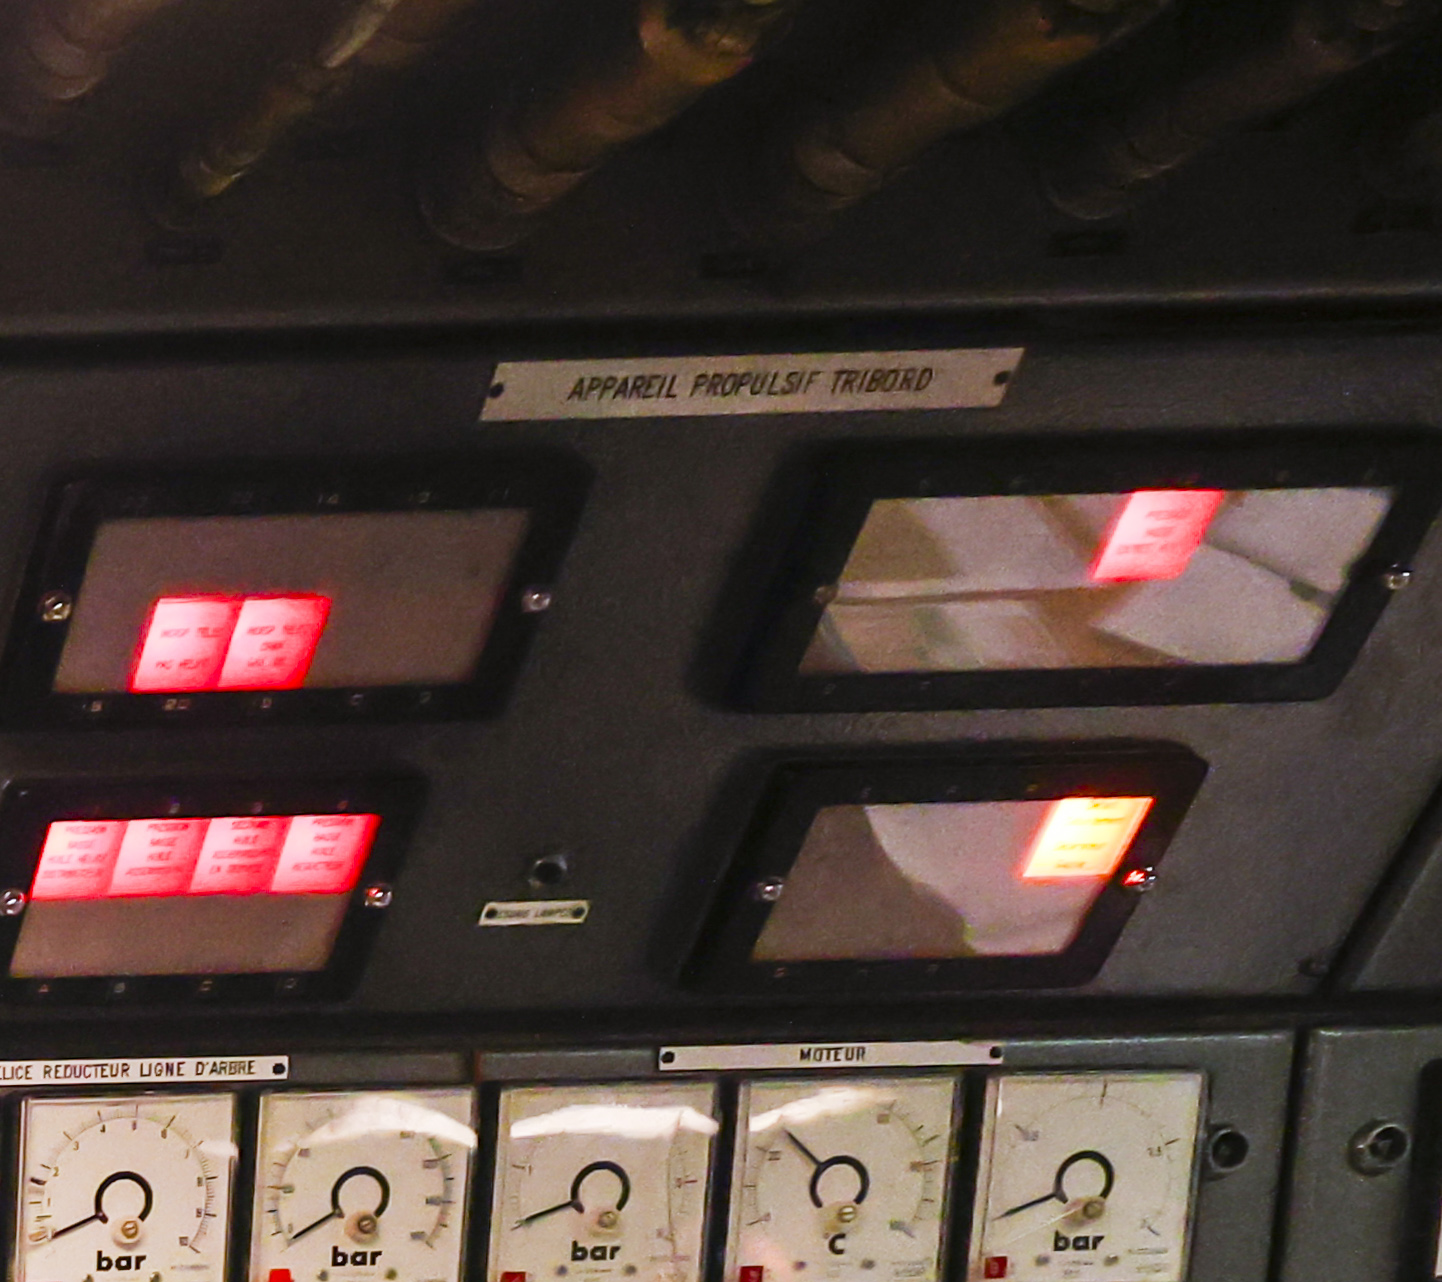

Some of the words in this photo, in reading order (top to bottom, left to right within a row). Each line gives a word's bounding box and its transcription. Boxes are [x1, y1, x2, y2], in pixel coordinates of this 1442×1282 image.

[567, 373, 678, 400] APPAREIL
[689, 369, 820, 397] PROPULSIF
[832, 366, 933, 393] TRIBORD
[800, 1046, 866, 1062] MOTEUR
[43, 1062, 130, 1079] REDUCTEUR
[140, 1061, 185, 1078] LIGNE
[195, 1059, 257, 1077] D'ARBRE
[570, 1240, 622, 1261] bar
[1053, 1230, 1104, 1252] bar
[96, 1250, 147, 1271] bar
[332, 1246, 383, 1267] bar
